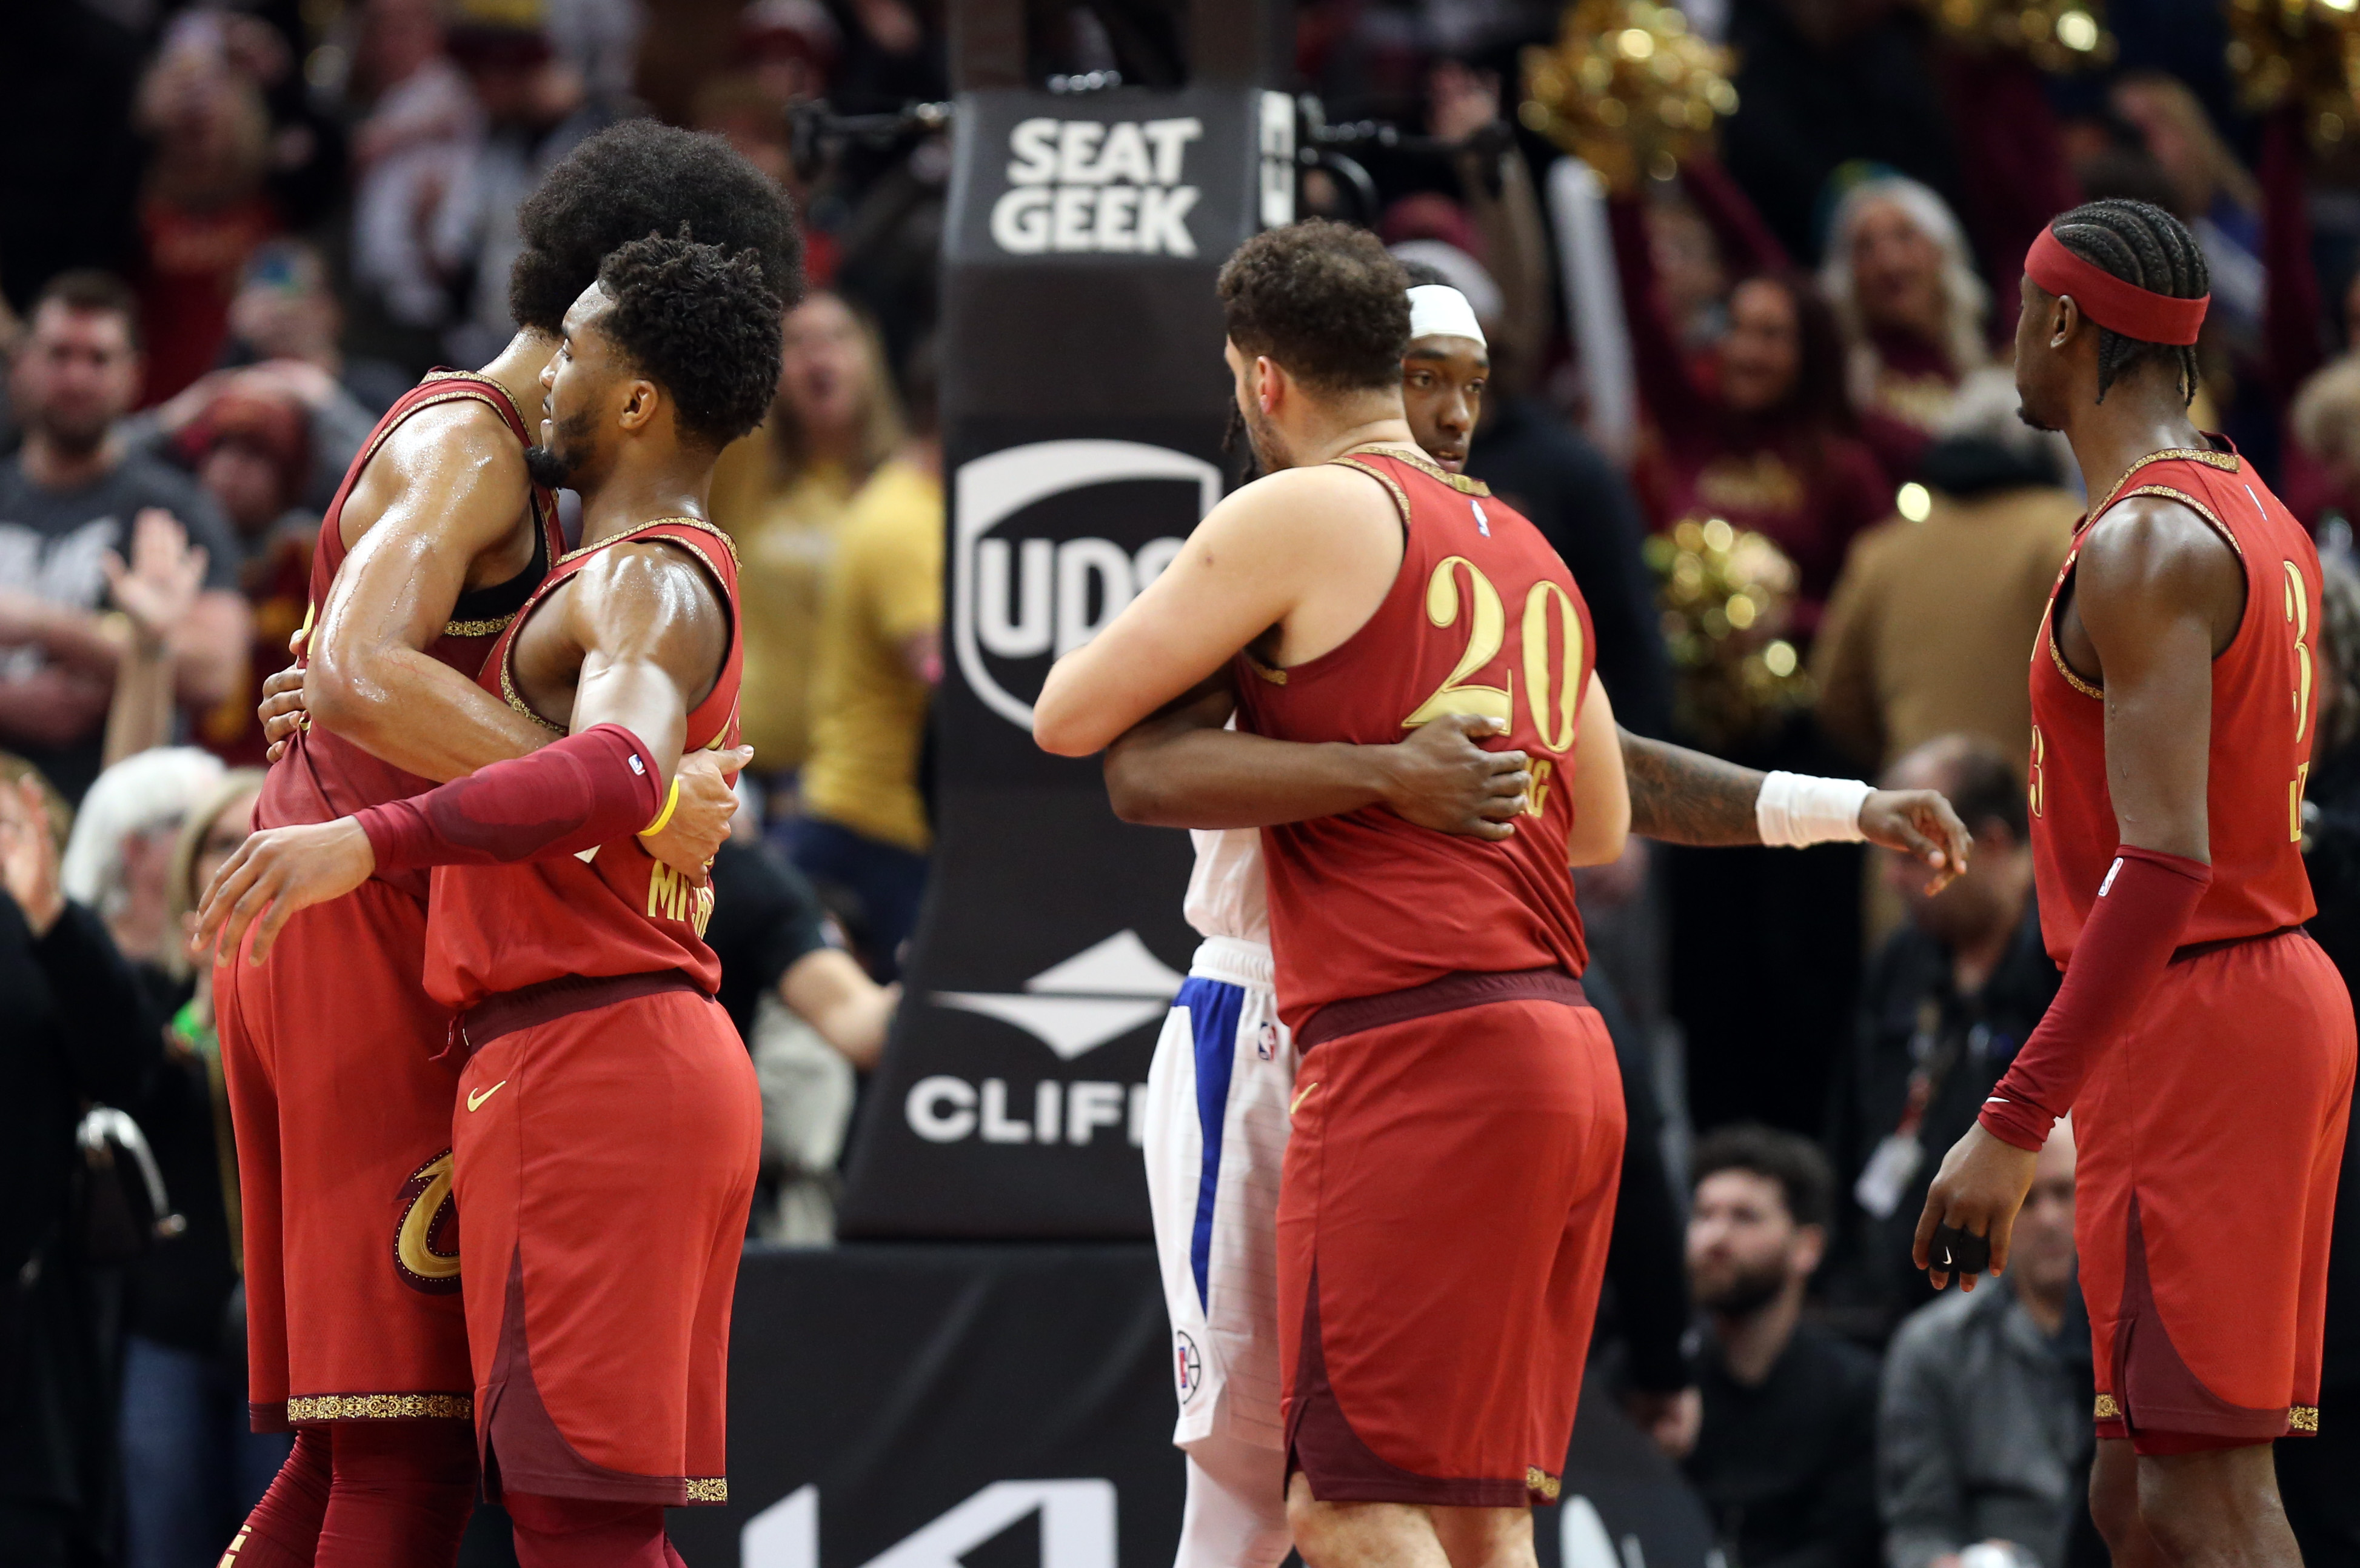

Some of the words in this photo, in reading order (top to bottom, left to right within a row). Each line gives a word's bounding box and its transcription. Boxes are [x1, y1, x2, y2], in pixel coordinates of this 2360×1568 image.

[1006, 117, 1203, 184] SEAT
[990, 184, 1202, 258] GEEK
[1401, 556, 1583, 753] 20
